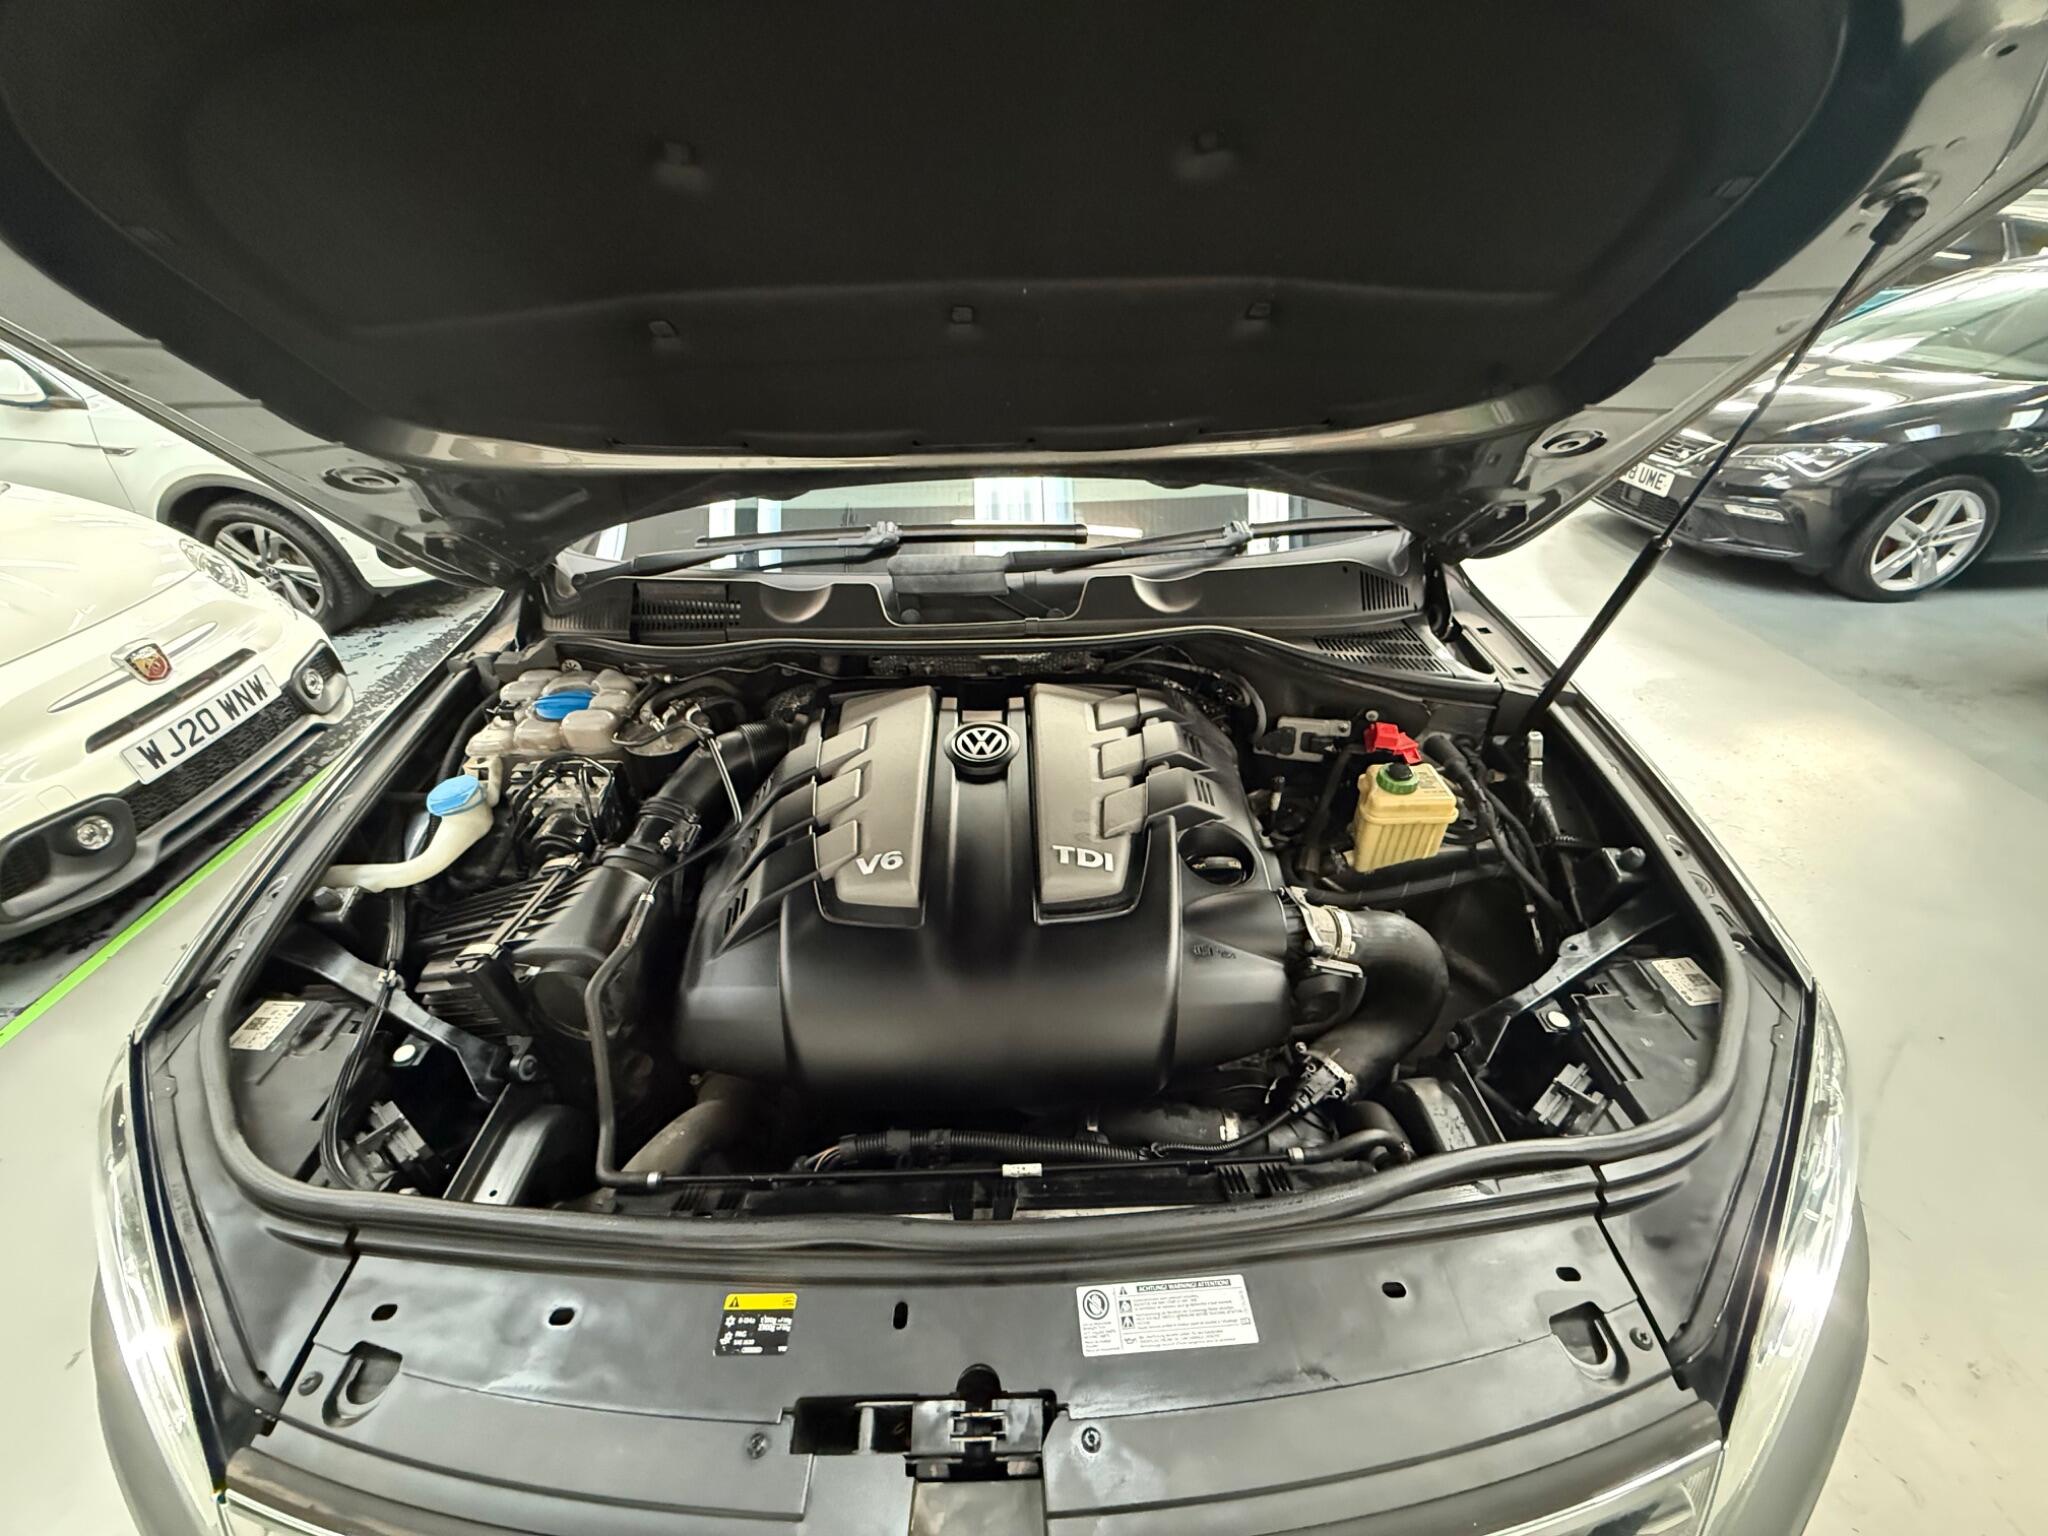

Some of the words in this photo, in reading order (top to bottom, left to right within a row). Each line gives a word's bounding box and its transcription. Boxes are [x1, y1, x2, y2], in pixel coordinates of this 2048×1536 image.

[1638, 466, 1666, 490] UME
[136, 707, 221, 770] WJ20
[216, 674, 268, 721] WNW
[855, 850, 904, 876] V6
[1052, 844, 1115, 872] TDI
